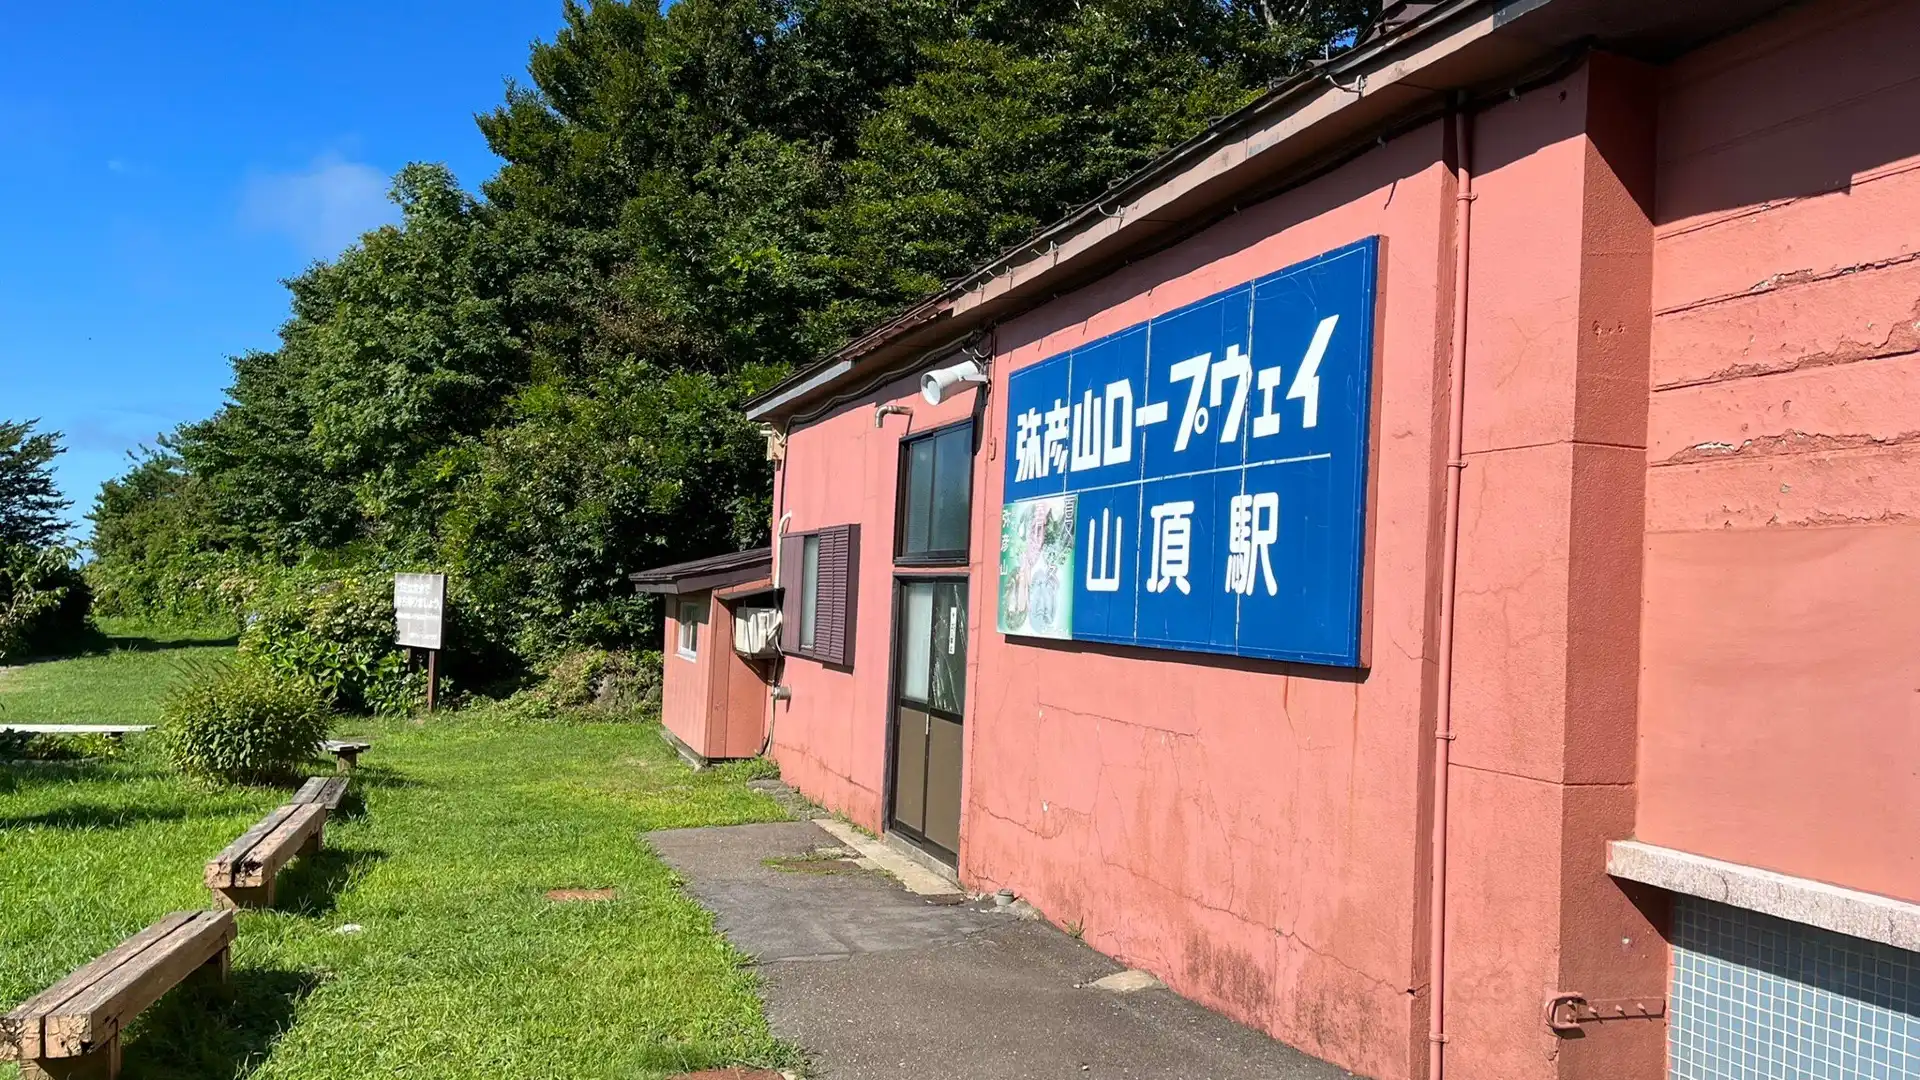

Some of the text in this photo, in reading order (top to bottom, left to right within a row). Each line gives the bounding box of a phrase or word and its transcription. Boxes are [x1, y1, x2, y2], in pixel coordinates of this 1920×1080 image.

[1014, 314, 1340, 483] 弥彦山ロープウェイ
[1086, 491, 1279, 596] 山頂駅
